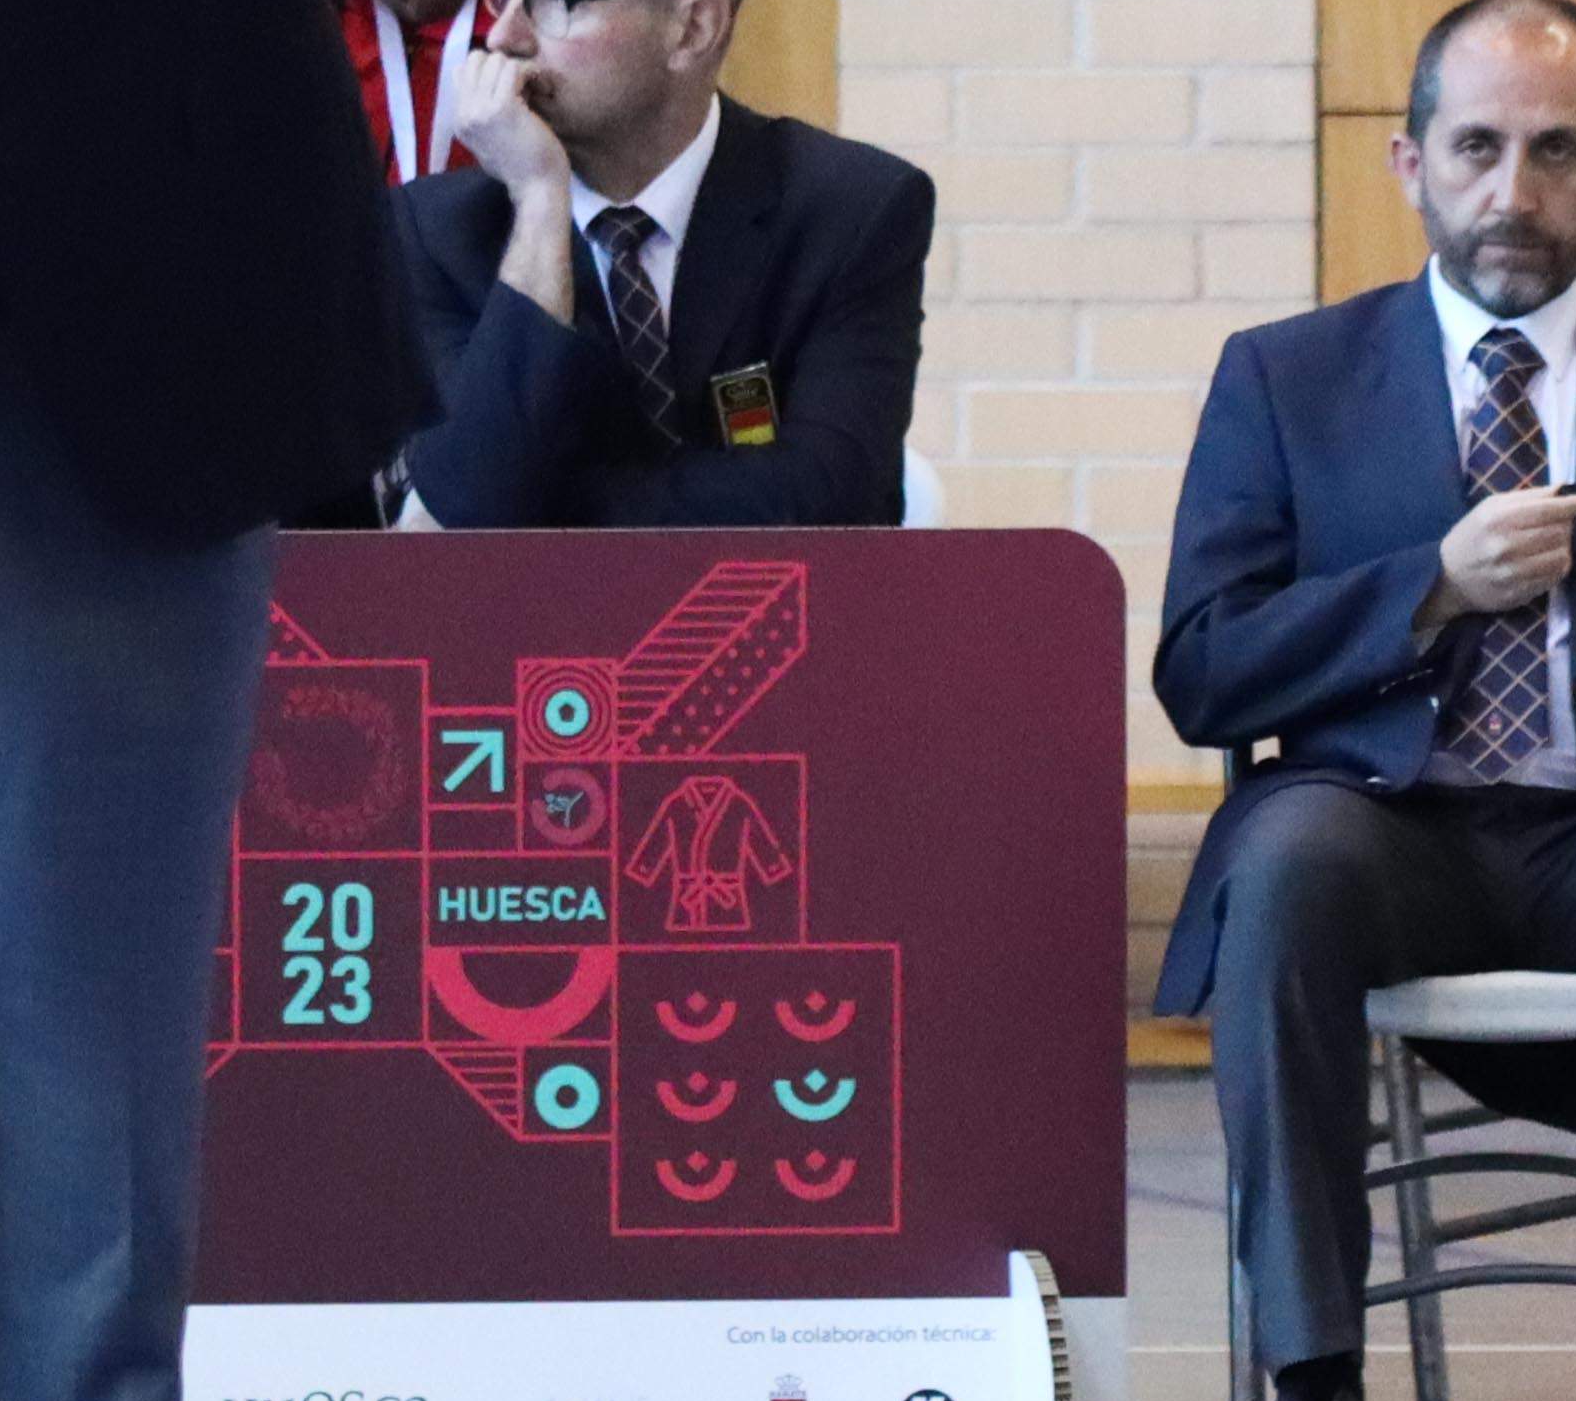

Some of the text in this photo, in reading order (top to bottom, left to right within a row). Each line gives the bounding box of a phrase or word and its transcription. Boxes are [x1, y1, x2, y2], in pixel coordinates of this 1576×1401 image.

[281, 882, 375, 952] 20
[438, 886, 606, 924] HUESCA
[281, 954, 373, 1026] 23
[727, 1326, 765, 1344] Con
[771, 1325, 787, 1344] la
[792, 1325, 918, 1345] colaboración
